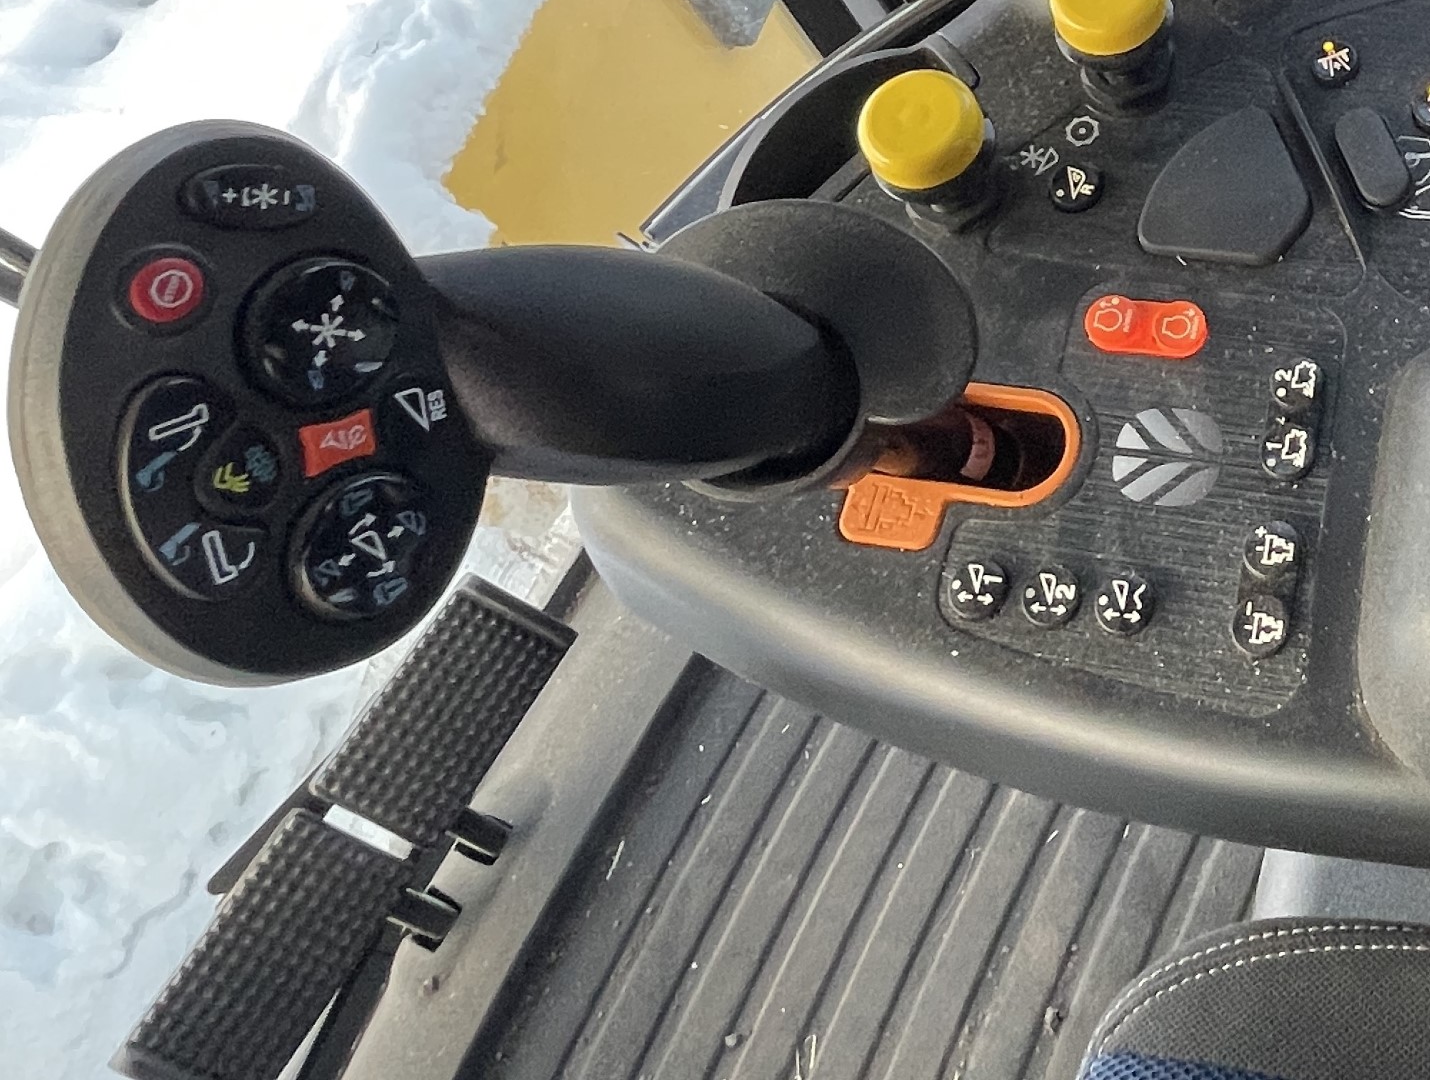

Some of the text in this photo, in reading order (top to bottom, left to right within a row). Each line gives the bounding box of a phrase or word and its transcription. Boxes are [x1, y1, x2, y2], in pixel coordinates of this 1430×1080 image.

[1274, 368, 1293, 382] 2
[1265, 441, 1283, 451] 1
[983, 574, 1003, 585] 1
[1054, 583, 1076, 601] 2
